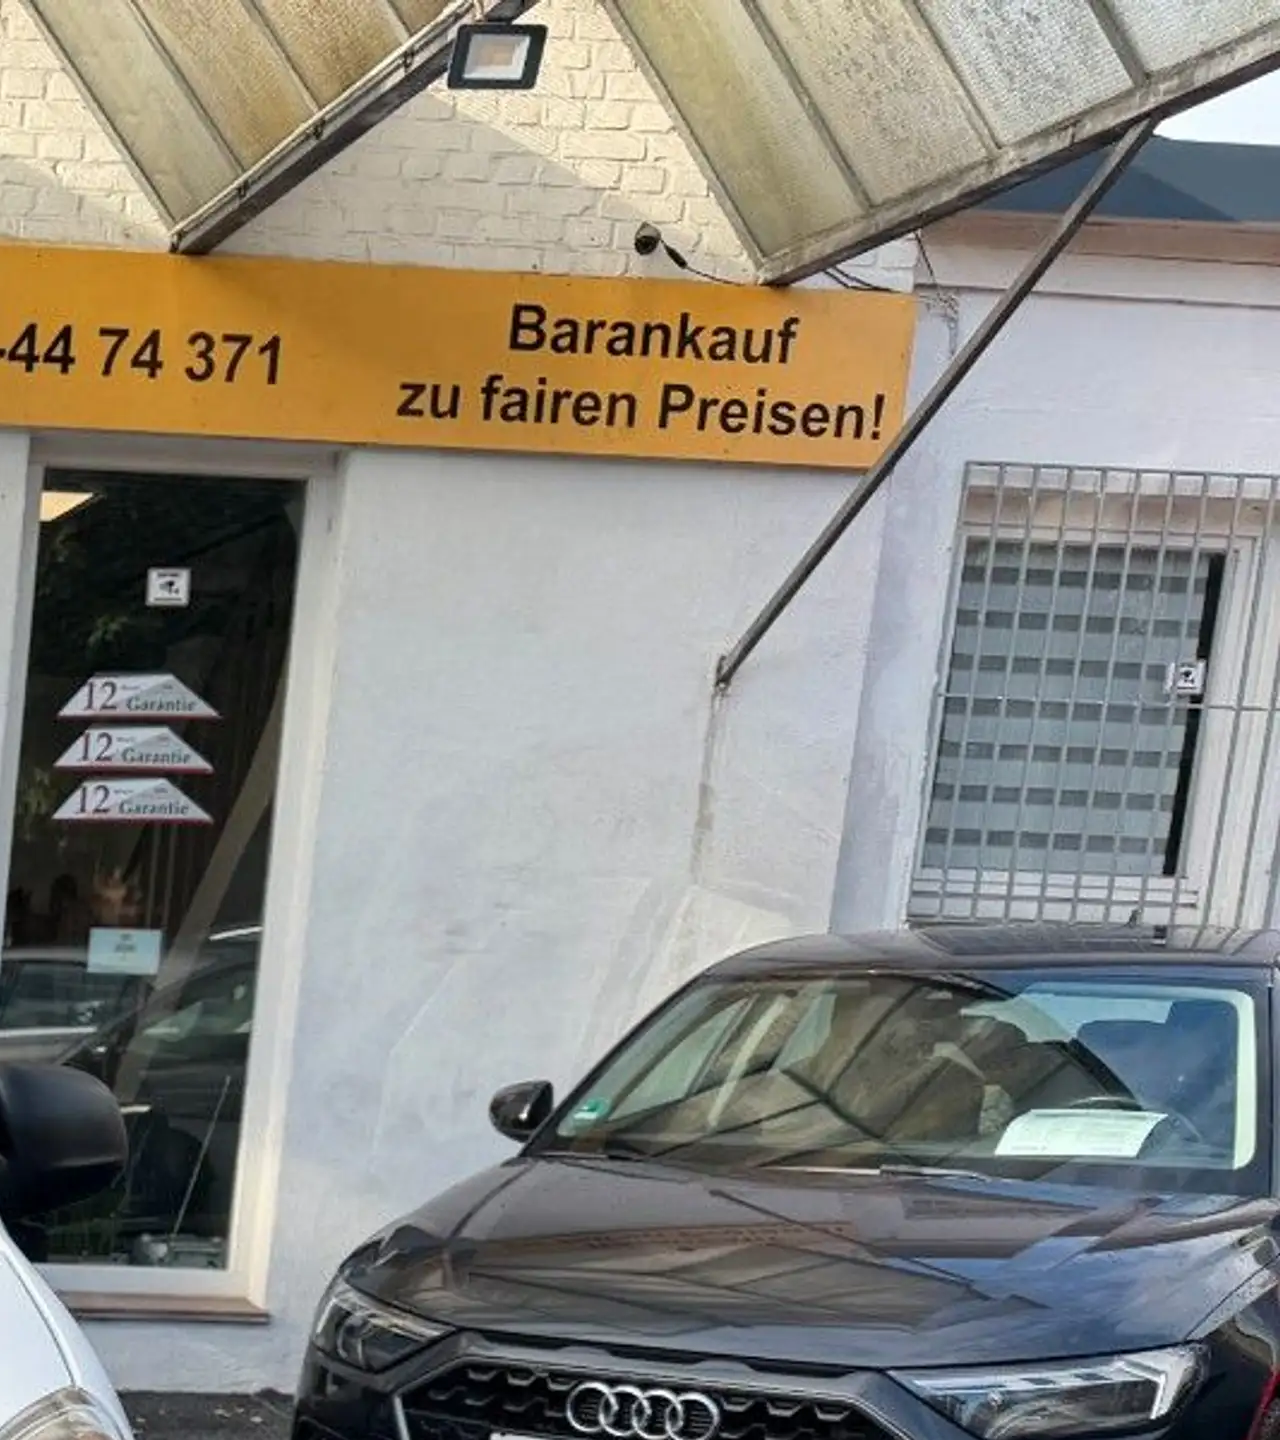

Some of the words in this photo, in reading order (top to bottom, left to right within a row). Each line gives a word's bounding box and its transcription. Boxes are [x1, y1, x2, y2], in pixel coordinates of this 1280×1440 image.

[98, 327, 164, 379] 74
[184, 331, 283, 385] 371
[508, 303, 800, 364] Barankauf
[396, 381, 460, 420] zu
[481, 374, 638, 429] fairen
[658, 382, 886, 441] Preisen!
[82, 681, 118, 712] 12
[125, 695, 196, 713] Garantie
[77, 732, 114, 763] 12
[120, 747, 191, 765] Garantie
[75, 785, 111, 815] 12
[118, 800, 189, 816] Garantie
